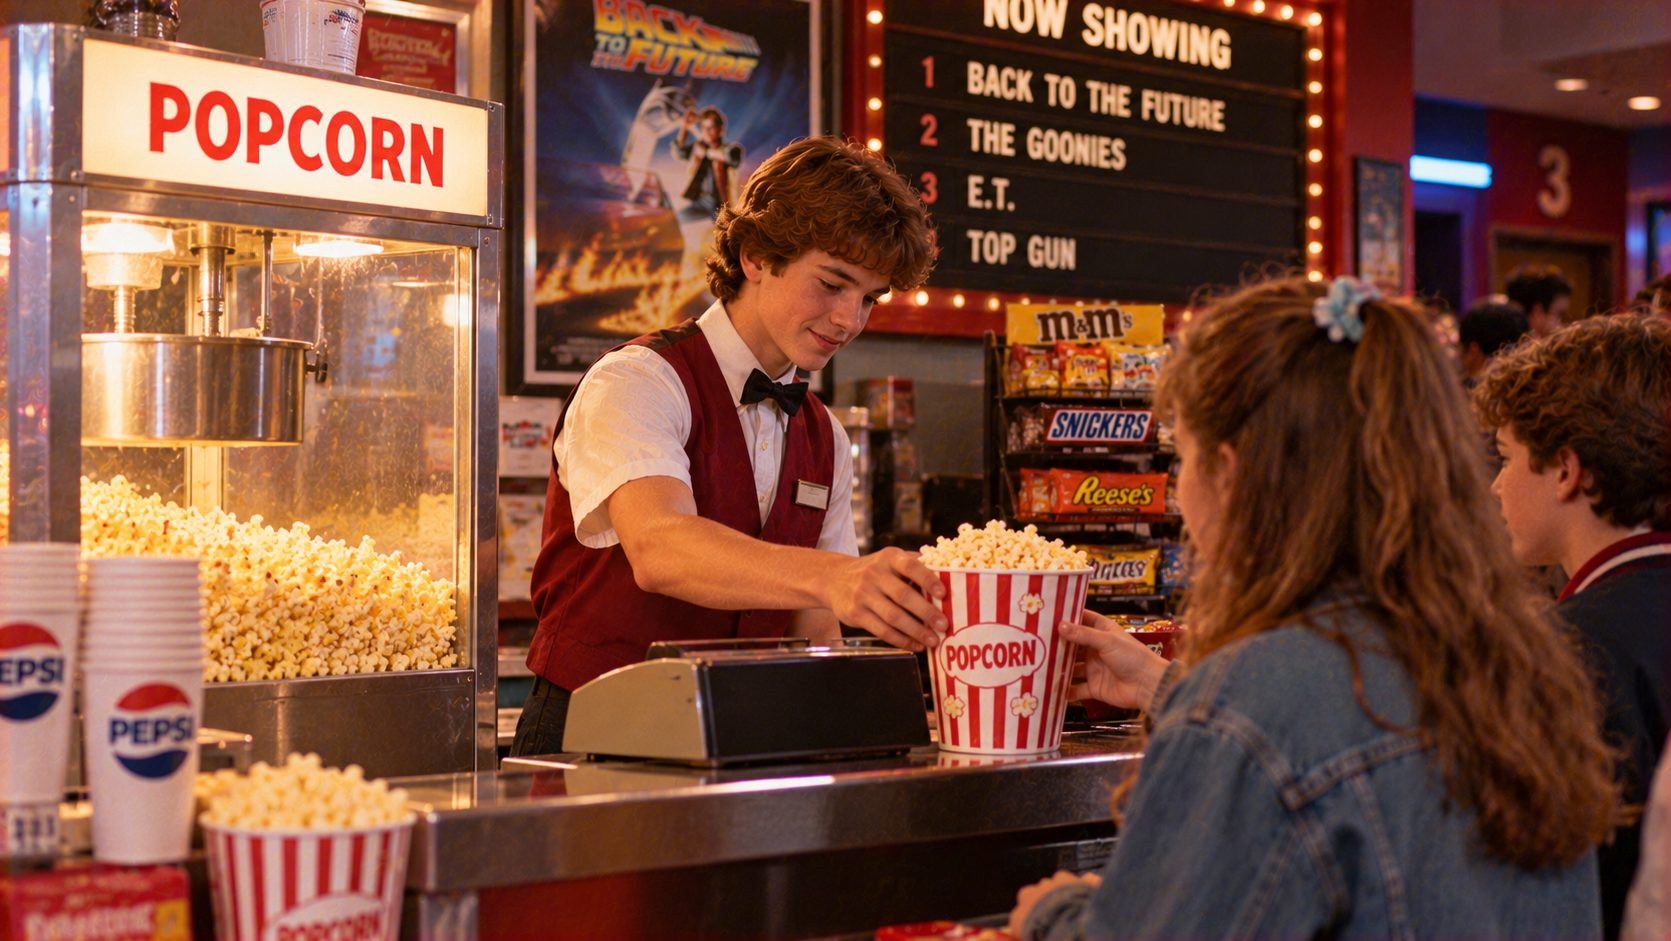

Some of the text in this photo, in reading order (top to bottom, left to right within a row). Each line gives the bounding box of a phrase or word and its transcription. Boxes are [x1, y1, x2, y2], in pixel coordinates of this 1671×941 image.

[594, 0, 722, 53] BACK
[596, 35, 627, 53] TO
[983, 0, 1232, 70] NOW SHOWING
[621, 38, 759, 82] FUTURE
[921, 56, 1226, 132] 1 BACK TO THE FUTURE
[149, 82, 444, 188] POPCORN
[920, 113, 1127, 171] 2 THE GOONIES
[920, 171, 1015, 211] 3 E.T.
[1537, 144, 1571, 219] 3
[966, 229, 1077, 271] TOP GUN
[1050, 411, 1149, 439] SNICKERS
[1071, 475, 1154, 506] Reese's
[0, 657, 63, 685] EPSI
[945, 638, 1037, 672] POPCORN
[110, 716, 193, 745] PEPSI
